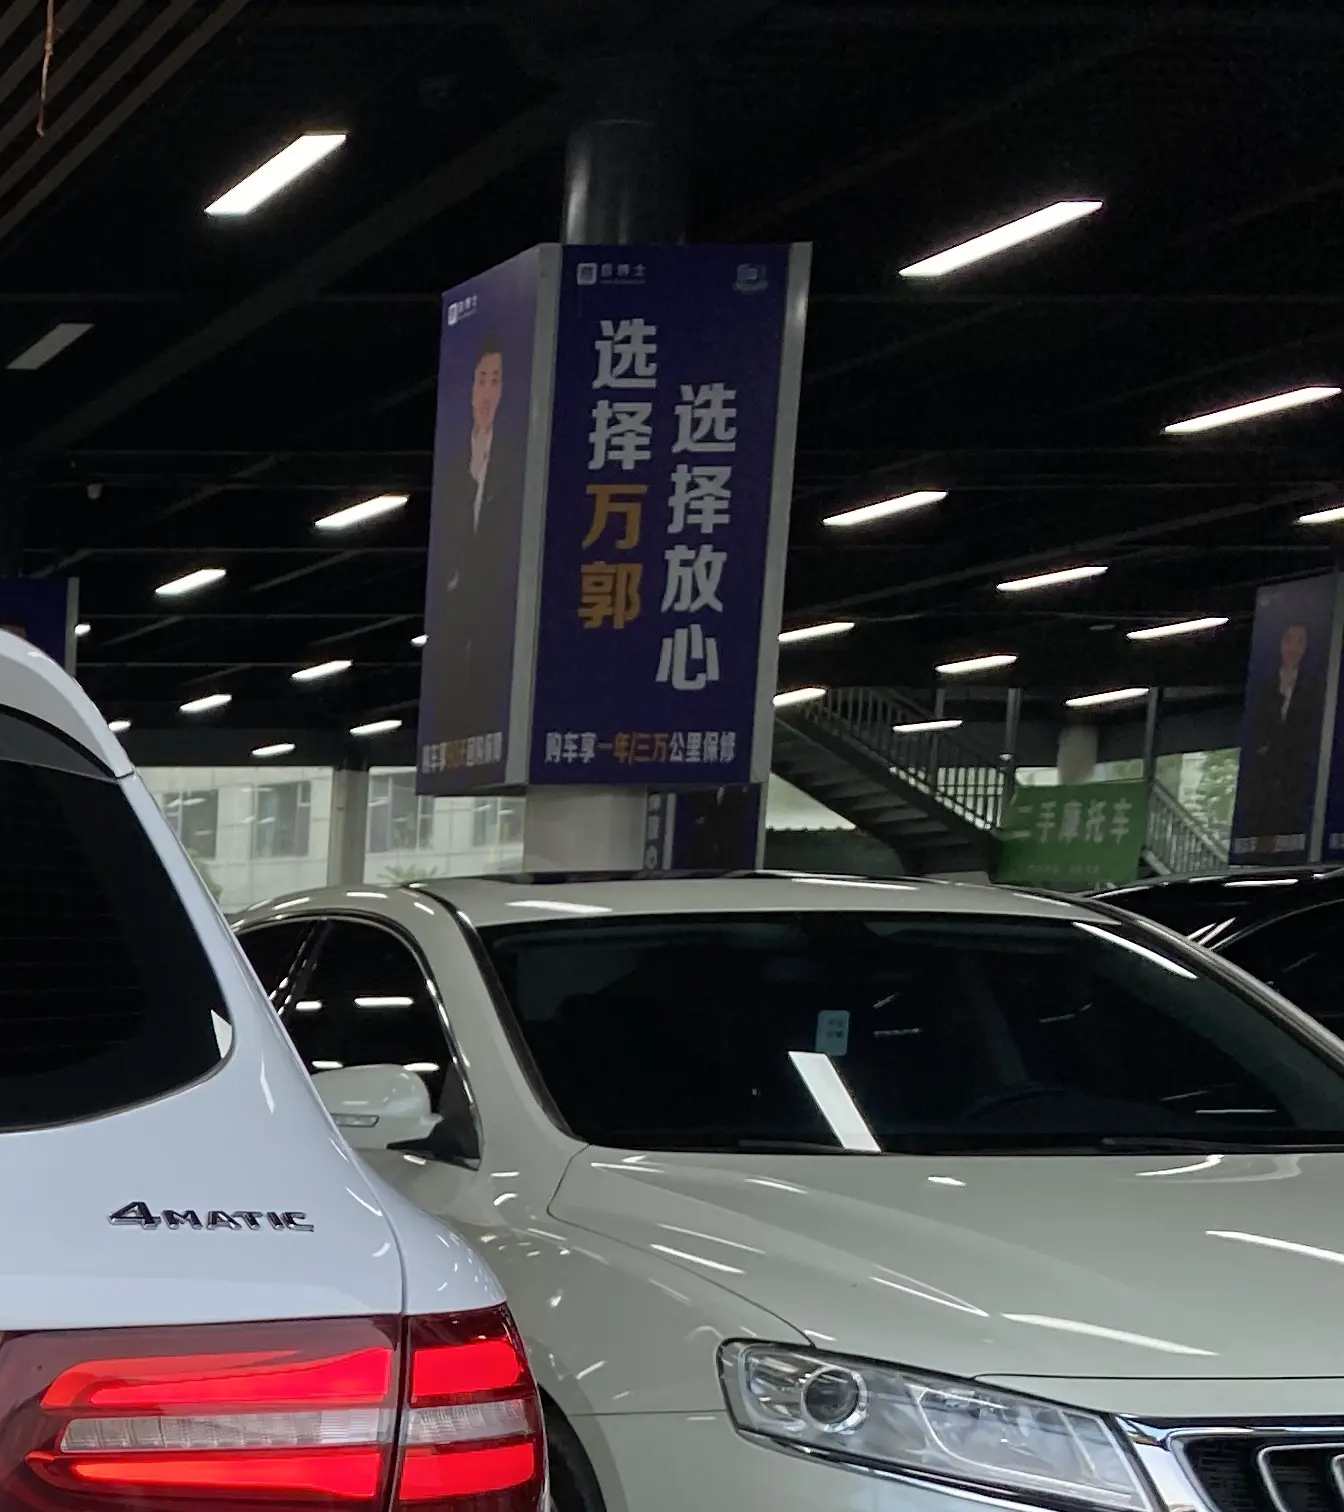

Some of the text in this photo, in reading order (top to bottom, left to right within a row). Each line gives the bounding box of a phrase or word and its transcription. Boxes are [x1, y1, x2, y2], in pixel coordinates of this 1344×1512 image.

[578, 317, 658, 630] 选择万郭
[655, 381, 738, 692] 选择放心
[107, 1200, 315, 1233] 4MATIC
